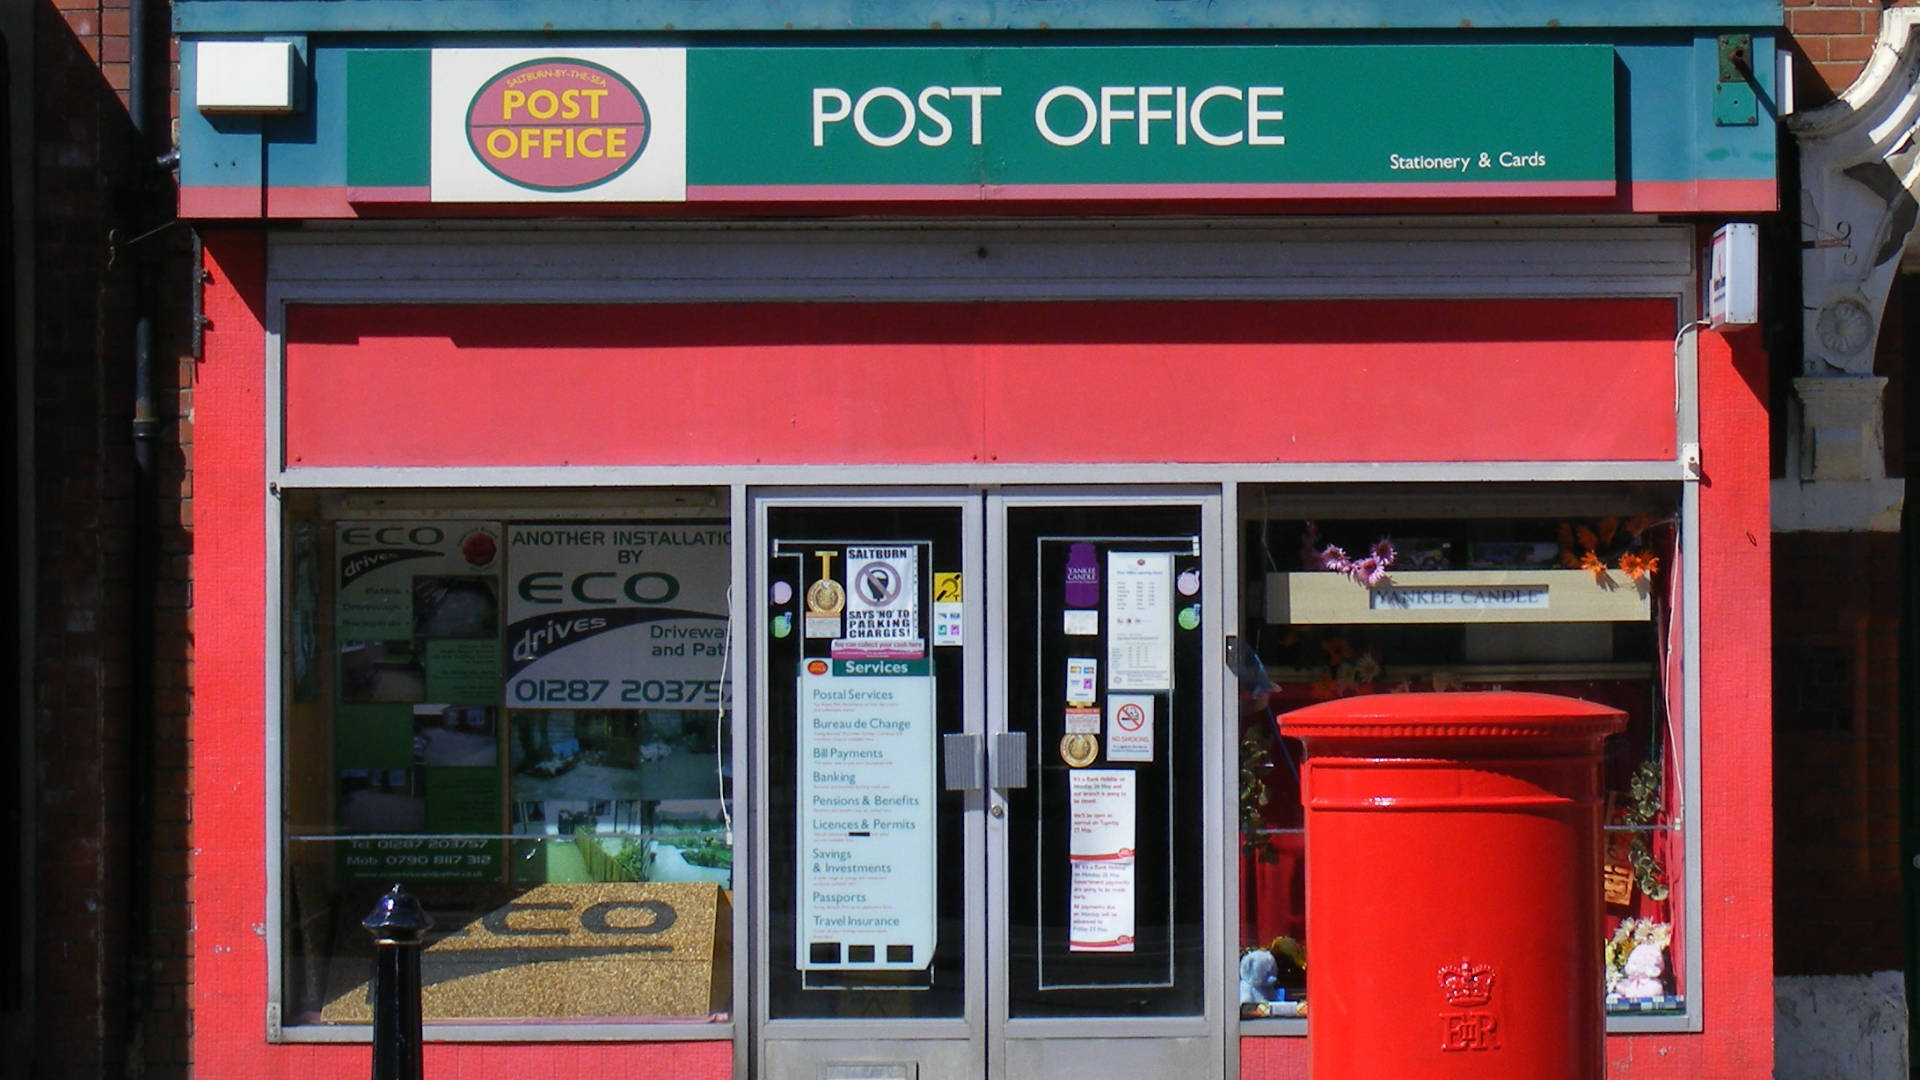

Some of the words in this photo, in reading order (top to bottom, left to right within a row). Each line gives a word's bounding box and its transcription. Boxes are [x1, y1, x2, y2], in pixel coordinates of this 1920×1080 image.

[503, 89, 609, 119] POST
[812, 85, 1002, 147] POST
[1034, 85, 1286, 147] OFFICE
[486, 128, 627, 158] OFFICE
[1389, 153, 1471, 173] Stationery
[1478, 152, 1491, 168] &
[1499, 151, 1547, 168] Cards
[342, 526, 445, 545] ECO
[512, 530, 605, 546] ANOTHER
[618, 550, 643, 564] BY
[848, 549, 907, 559] SALTBURN
[518, 571, 681, 605] ECO
[1376, 588, 1454, 605] YANKEE
[1460, 588, 1539, 605] CANDLE
[849, 610, 874, 619] SAYS
[897, 609, 910, 617] TO
[849, 619, 910, 629] PARKING
[651, 625, 732, 639] Drivewa
[849, 628, 910, 639] CHARGES!
[513, 617, 608, 662] drives
[652, 643, 685, 657] and
[693, 643, 731, 657] Pat
[845, 660, 909, 674] Services
[515, 680, 610, 702] 01287
[813, 689, 846, 700] Postal
[848, 689, 894, 700] Services
[813, 718, 851, 729] Bureau
[853, 718, 867, 729] de
[869, 718, 911, 731] Change
[813, 748, 828, 759] Bill
[830, 748, 884, 761] Payments
[813, 771, 856, 784] Banking
[813, 795, 860, 806] Pensions
[862, 795, 870, 806] &
[874, 795, 920, 806] Benefits
[813, 819, 859, 830] Licences
[861, 819, 869, 830] &
[873, 819, 916, 830] Permits
[386, 855, 429, 865] 0790
[467, 855, 491, 865] 312
[813, 848, 852, 861] Savings
[813, 862, 821, 873] &
[825, 862, 892, 873] Investments
[813, 891, 866, 904] Passports
[476, 900, 678, 937] CO
[814, 915, 846, 926] Travel
[848, 916, 900, 926] Insurance
